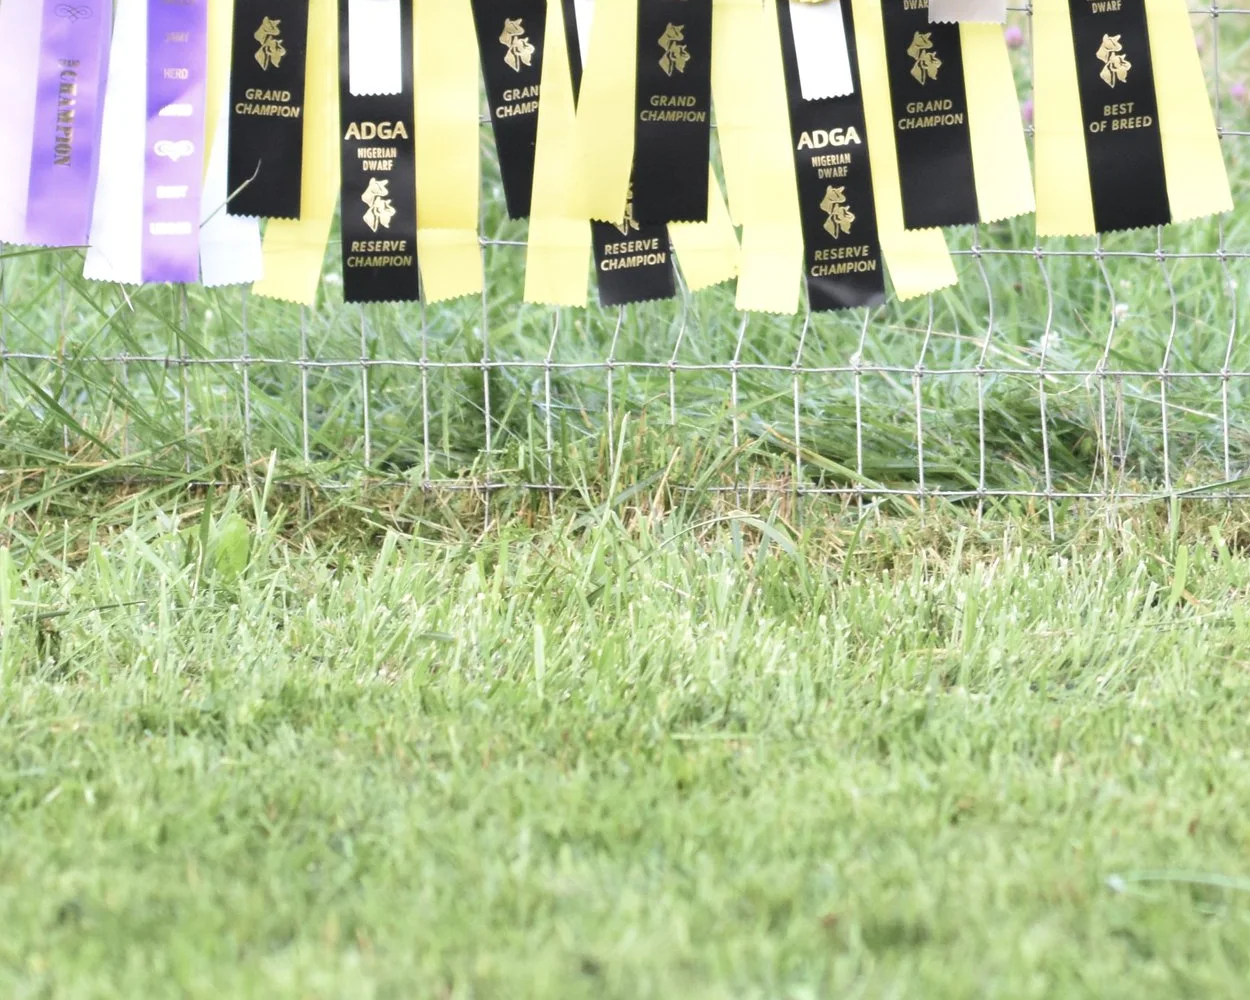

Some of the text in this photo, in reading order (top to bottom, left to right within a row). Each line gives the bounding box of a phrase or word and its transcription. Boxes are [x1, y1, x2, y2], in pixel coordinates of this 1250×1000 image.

[1092, 0, 1122, 14] DWARF
[163, 68, 189, 80] HERD
[245, 88, 291, 102] GRAND
[503, 84, 540, 101] GRAN
[650, 95, 697, 107] GRAND
[906, 99, 953, 113] GRAND
[235, 102, 300, 118] CHAMPION
[640, 110, 706, 122] CHAMPION
[1103, 102, 1135, 117] BEST
[53, 69, 78, 167] CHAMPION
[897, 113, 964, 130] CHAMPION
[1089, 115, 1153, 133] OF BREED
[344, 120, 409, 140] ADGA
[797, 126, 862, 150] ADGA
[357, 147, 398, 159] NIGERIAN
[811, 152, 852, 168] NIGERIAN
[362, 160, 393, 171] DWARF
[817, 165, 848, 179] DWARF
[351, 240, 407, 253] RESERVE
[604, 238, 659, 255] RESERVE
[814, 245, 870, 261] RESERVE
[346, 255, 413, 268] CHAMPION
[600, 252, 666, 271] CHAMPION
[811, 259, 877, 277] CHAMPION
